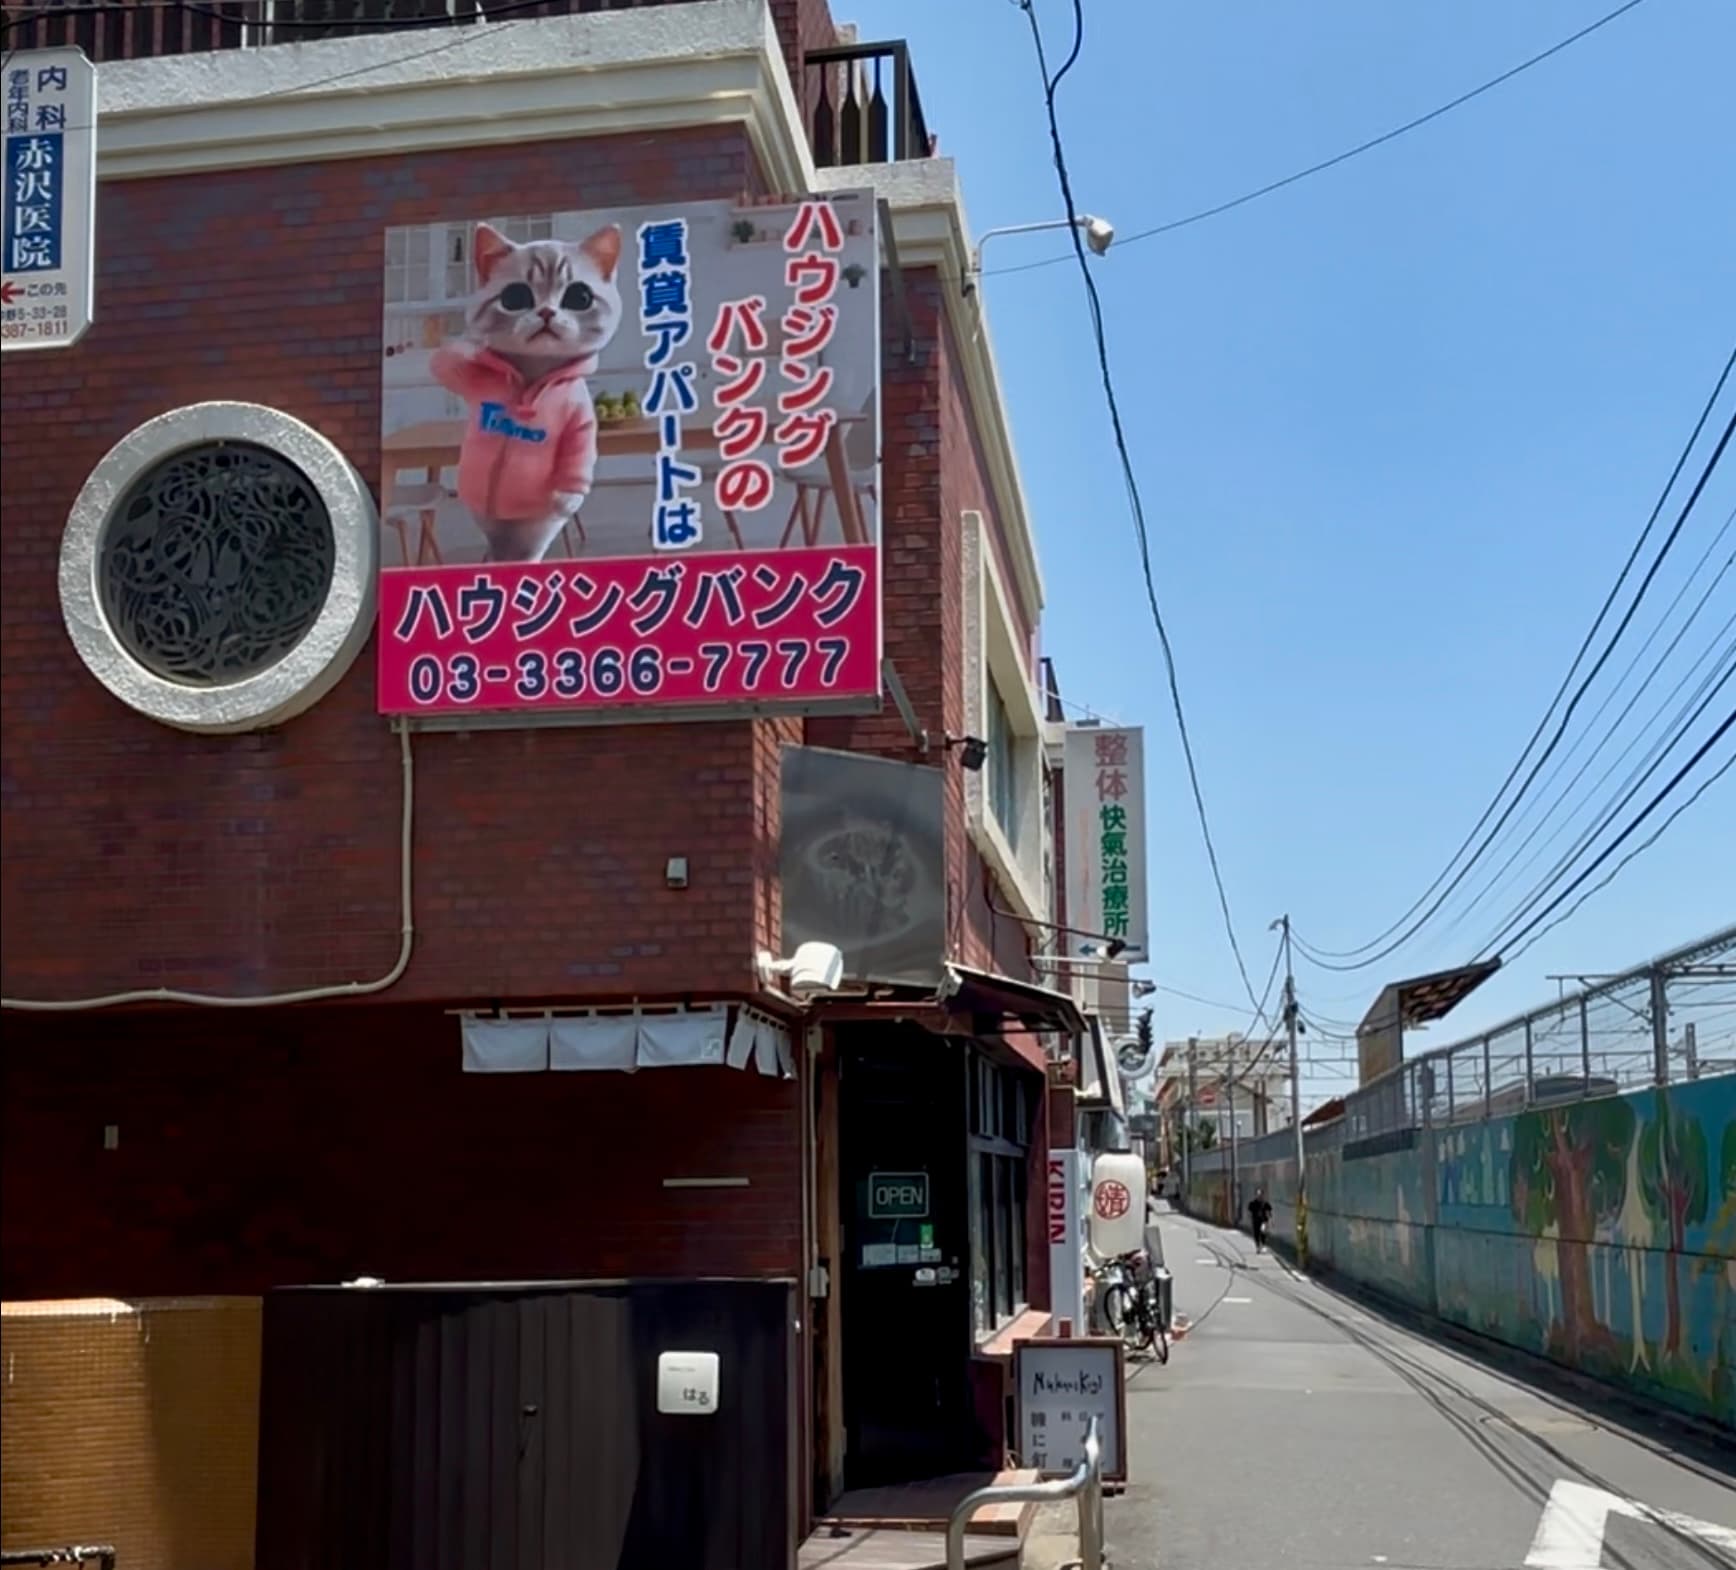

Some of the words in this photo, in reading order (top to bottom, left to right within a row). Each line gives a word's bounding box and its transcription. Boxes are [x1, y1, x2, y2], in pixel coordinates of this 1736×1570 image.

[36, 65, 67, 131] 内科
[12, 138, 53, 269] 赤沢医院
[635, 219, 703, 550] 賃貸アパートは
[776, 201, 844, 467] ハウジング
[707, 297, 773, 512] バンクの
[394, 559, 866, 646] ハウジングバンク
[409, 638, 850, 704] 03-3366-7777
[1094, 733, 1128, 802] 整体
[1099, 804, 1130, 937] 快氣治療所
[876, 1185, 924, 1206] OPEN
